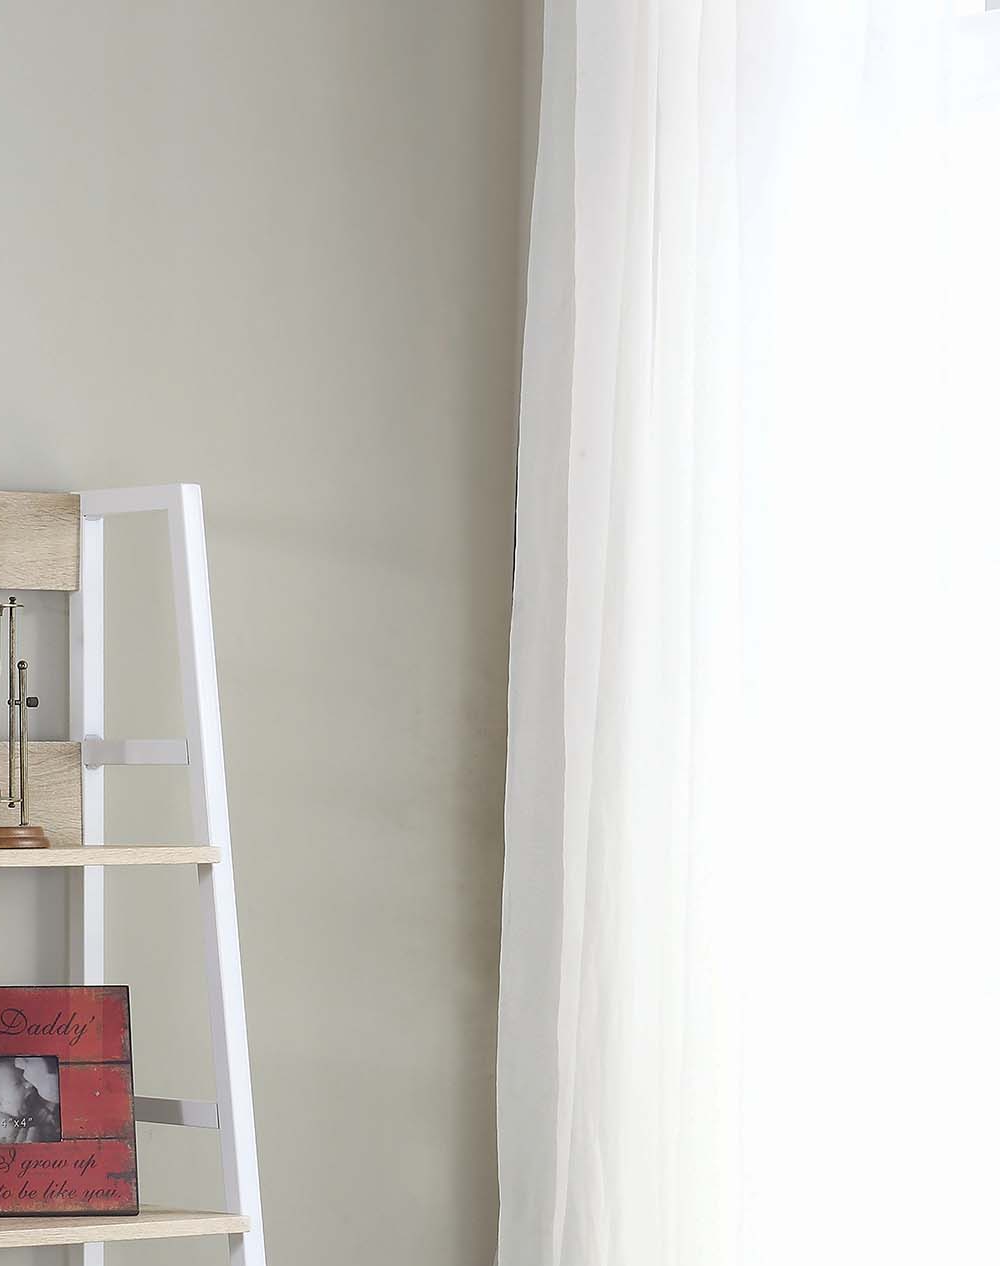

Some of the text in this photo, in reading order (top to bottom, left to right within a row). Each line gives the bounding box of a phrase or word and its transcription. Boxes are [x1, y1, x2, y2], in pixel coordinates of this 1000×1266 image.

[18, 1160, 69, 1178] grow
[73, 1153, 96, 1175] up
[18, 1181, 37, 1200] be
[43, 1180, 77, 1200] like
